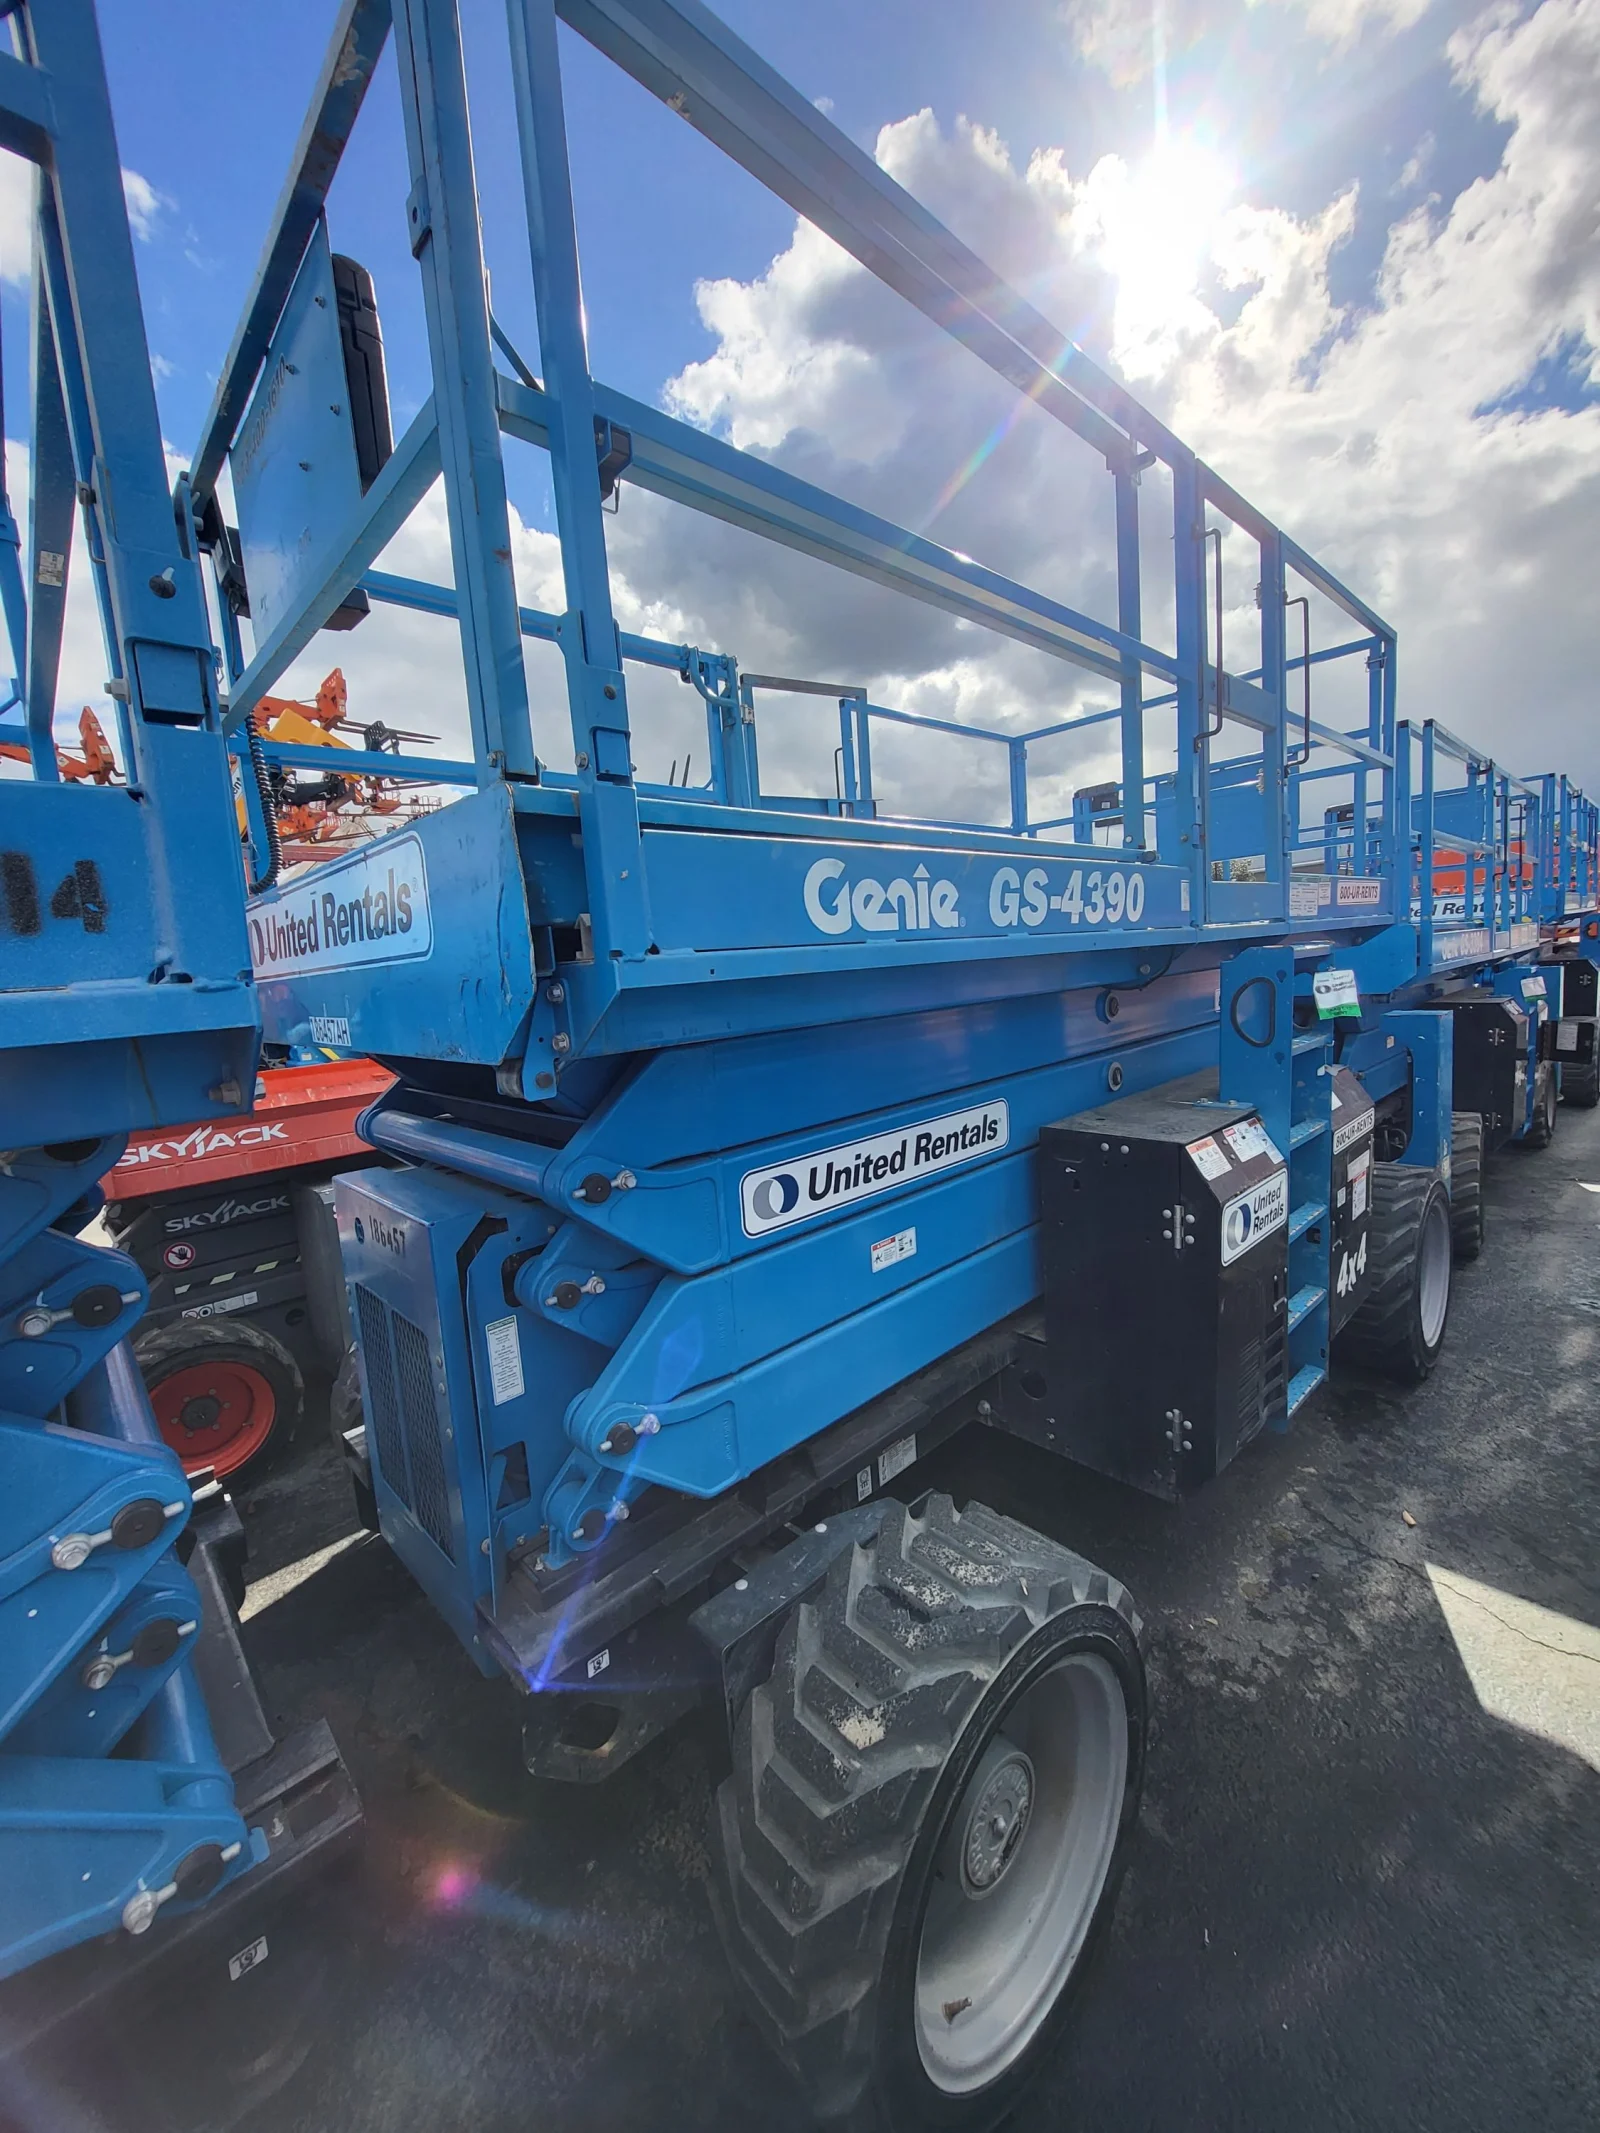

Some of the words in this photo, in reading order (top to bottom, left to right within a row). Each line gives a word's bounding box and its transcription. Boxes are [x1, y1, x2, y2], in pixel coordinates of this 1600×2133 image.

[803, 858, 959, 935] Genie
[989, 867, 1145, 927] GS-4390
[1339, 885, 1379, 900] 800-UR-RENTS
[265, 899, 319, 961] United
[322, 868, 413, 948] Rentals
[310, 1017, 350, 1045] 186457AH
[114, 1122, 289, 1167] SKYJACK
[1335, 1112, 1374, 1149] 800-UR-RENTS
[808, 1139, 908, 1202] United
[914, 1114, 999, 1166] Rentals
[165, 1195, 291, 1233] SKYJACK
[1253, 1182, 1282, 1215] United
[368, 1214, 406, 1258] 186457
[1252, 1202, 1284, 1236] Rentals
